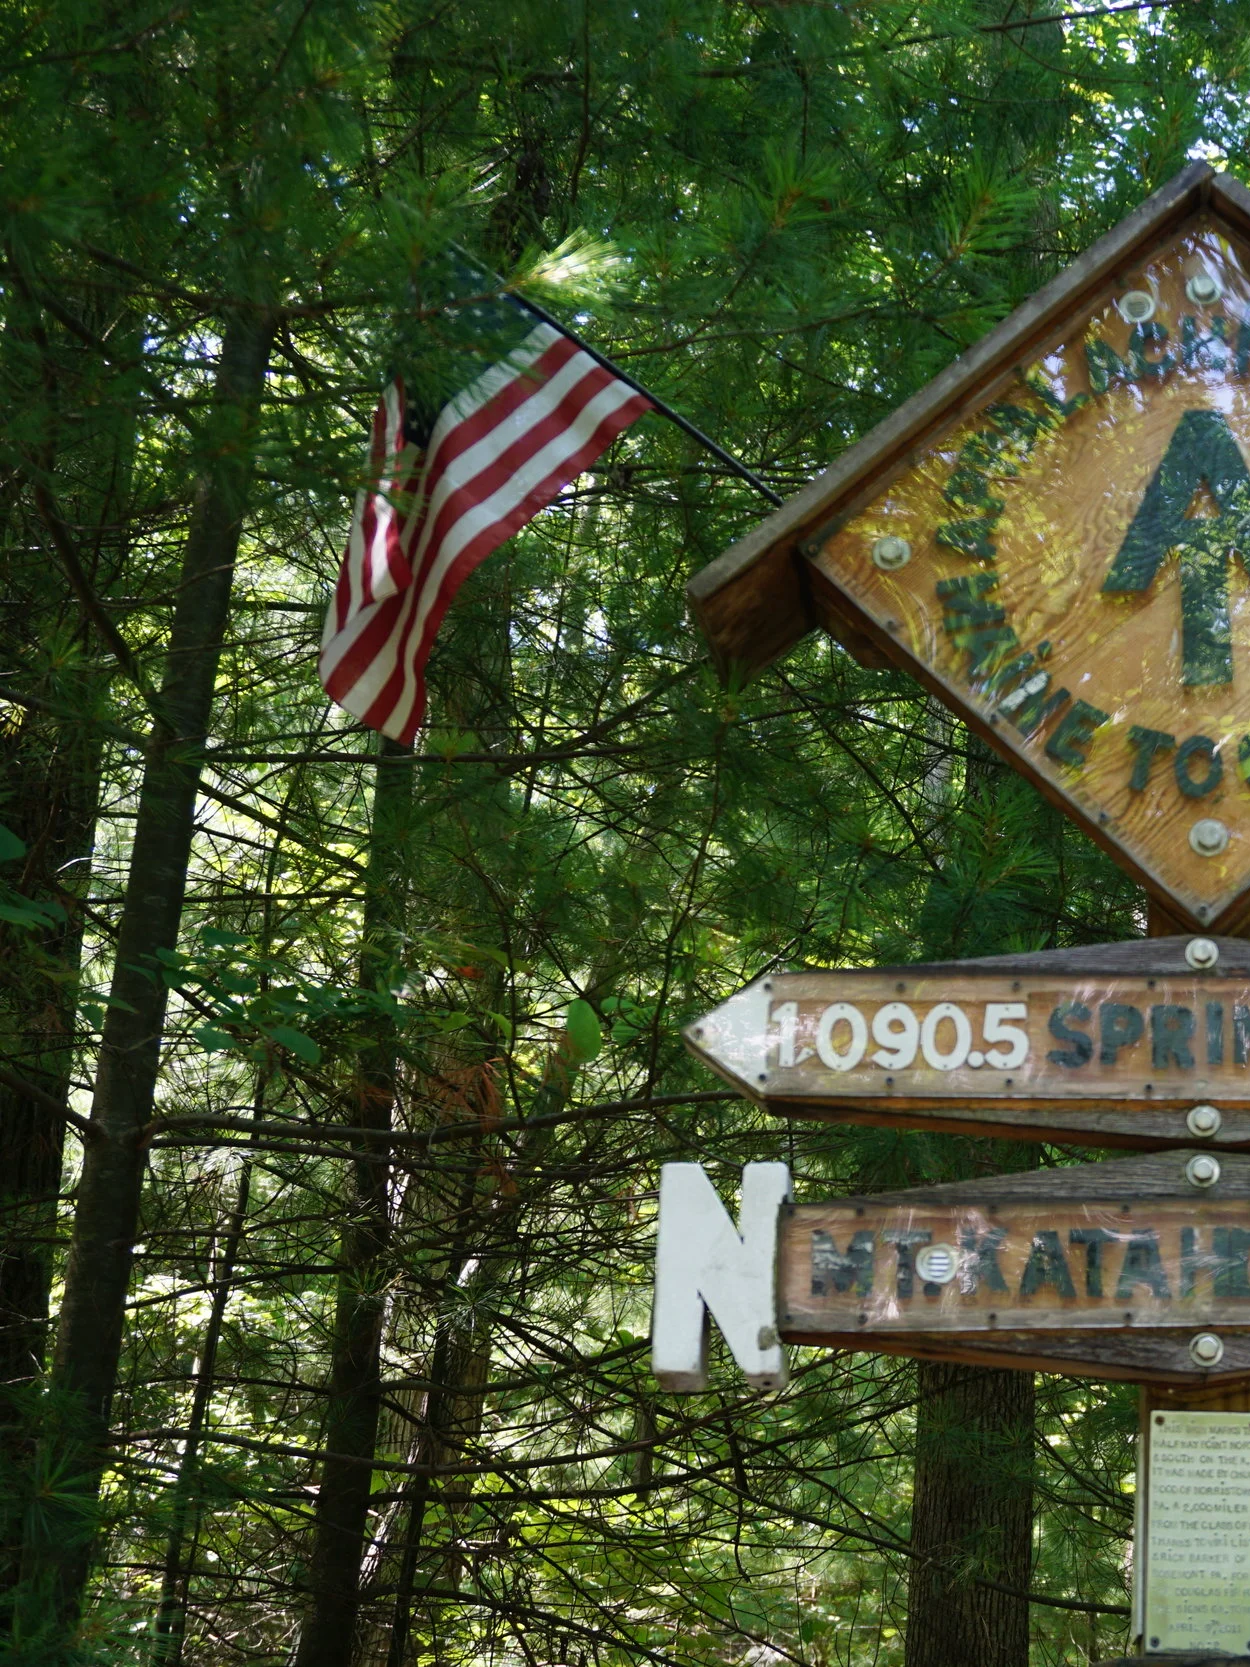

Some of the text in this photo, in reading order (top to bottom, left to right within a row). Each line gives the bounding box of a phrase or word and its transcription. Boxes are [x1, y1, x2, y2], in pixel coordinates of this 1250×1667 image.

[1126, 724, 1224, 799] TO
[770, 1001, 1030, 1072] 1,090.5
[652, 1162, 792, 1390] N
[811, 1229, 942, 1299] MT.
[1218, 1455, 1238, 1465] THE
[1180, 1520, 1198, 1530] THE
